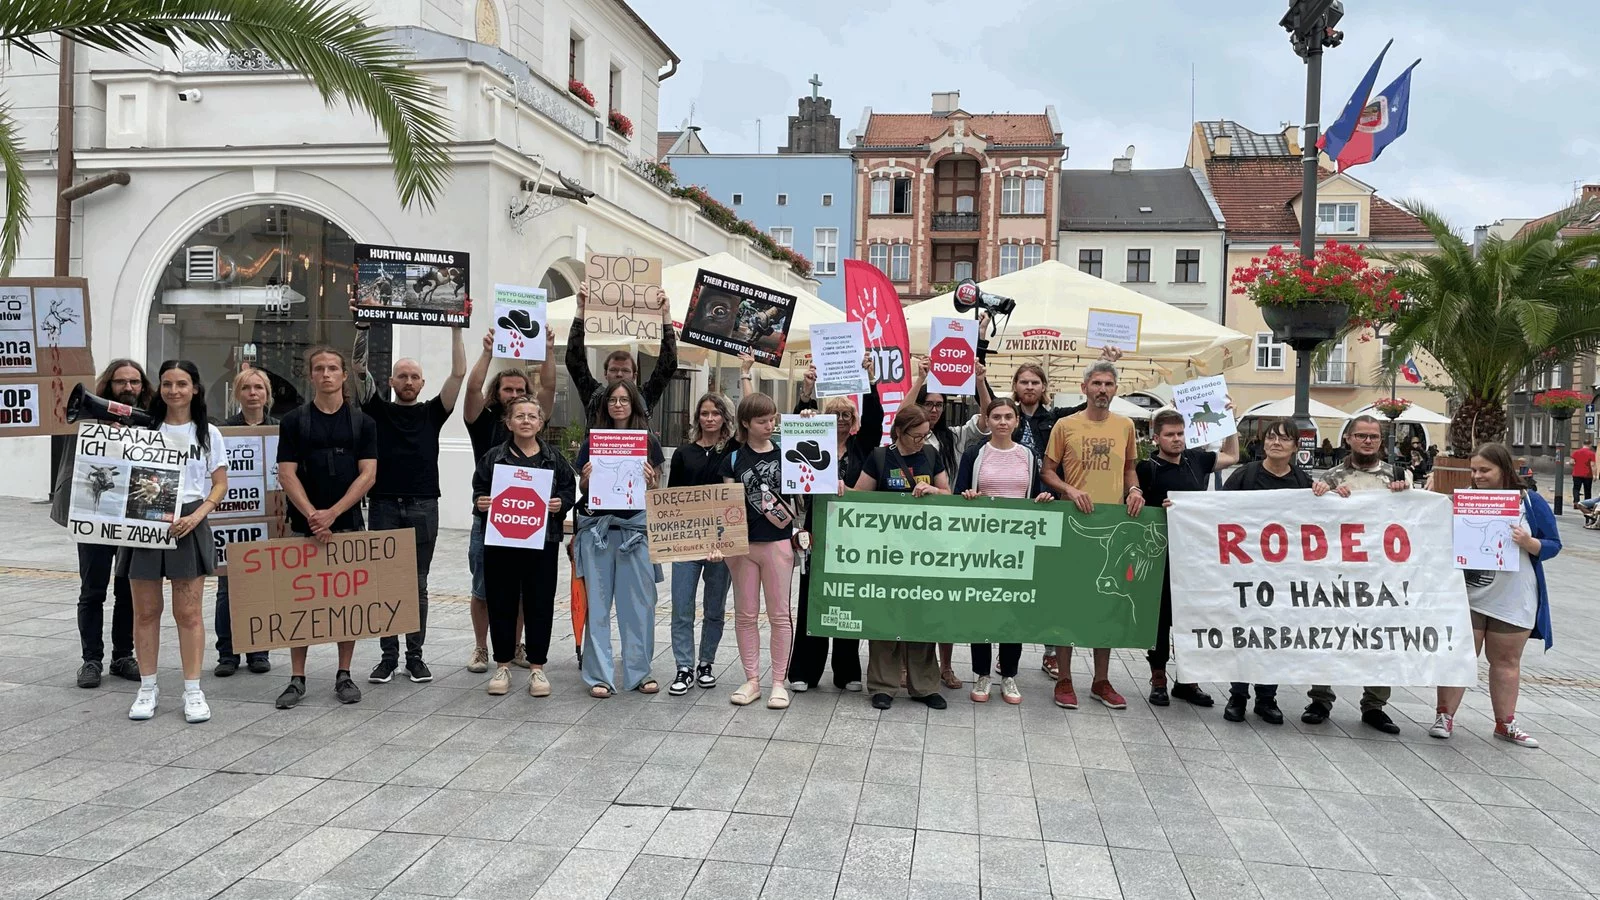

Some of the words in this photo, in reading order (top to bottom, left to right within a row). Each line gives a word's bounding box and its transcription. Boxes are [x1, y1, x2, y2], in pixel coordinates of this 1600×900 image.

[370, 249, 412, 261] HURTING
[414, 252, 454, 264] ANIMALS
[588, 255, 649, 283] STOP
[588, 279, 663, 310] RODEO
[703, 275, 722, 287] THEIR
[723, 281, 740, 292] EYES
[740, 285, 754, 296] BEG
[754, 290, 767, 300] FOR
[768, 293, 790, 306] MERCY
[358, 309, 394, 319] DOESN'T
[396, 311, 419, 320] MAKE
[421, 312, 438, 321] YOU
[440, 314, 445, 322] A
[447, 315, 464, 323] MAN
[585, 316, 664, 339] GLIWICACH
[689, 331, 701, 340] YOU
[701, 335, 715, 345] CALL
[1006, 340, 1077, 351] ZWIERZYNIEC
[939, 349, 967, 358] STOP
[933, 362, 972, 374] RODEO!
[1201, 381, 1222, 389] rodeo
[1185, 390, 1215, 402] PreZero!
[80, 424, 166, 448] ZABAWA
[81, 441, 106, 457] ICH
[122, 444, 189, 465] KOSZTEM
[501, 498, 535, 510] STOP
[653, 488, 729, 506] DRĘCZENIE
[494, 512, 541, 527] RODEO!
[657, 509, 683, 519] ORAZ
[837, 507, 943, 534] Krzywda
[947, 513, 1048, 540] zwierząt
[70, 520, 94, 535] TO
[101, 522, 122, 540] NIE
[213, 528, 262, 547] STOP
[652, 528, 709, 543] ZWIERZĄT
[711, 541, 735, 549] RODEO
[1218, 523, 1411, 564] RODEO
[242, 543, 318, 573] STOP
[326, 536, 396, 566] RODEO
[835, 544, 860, 565] to
[867, 545, 904, 565] nie
[910, 549, 1025, 570] rozrywka!
[292, 569, 369, 601] STOP
[823, 581, 855, 598] NIE
[859, 583, 888, 600] dla
[891, 584, 944, 601] rodeo
[948, 589, 962, 602] w
[965, 587, 1037, 603] PreZero!
[1233, 580, 1275, 608] TO
[1290, 573, 1410, 608] HAŃBA!
[250, 599, 401, 645] PRZEMOCY
[1192, 627, 1223, 649] TO
